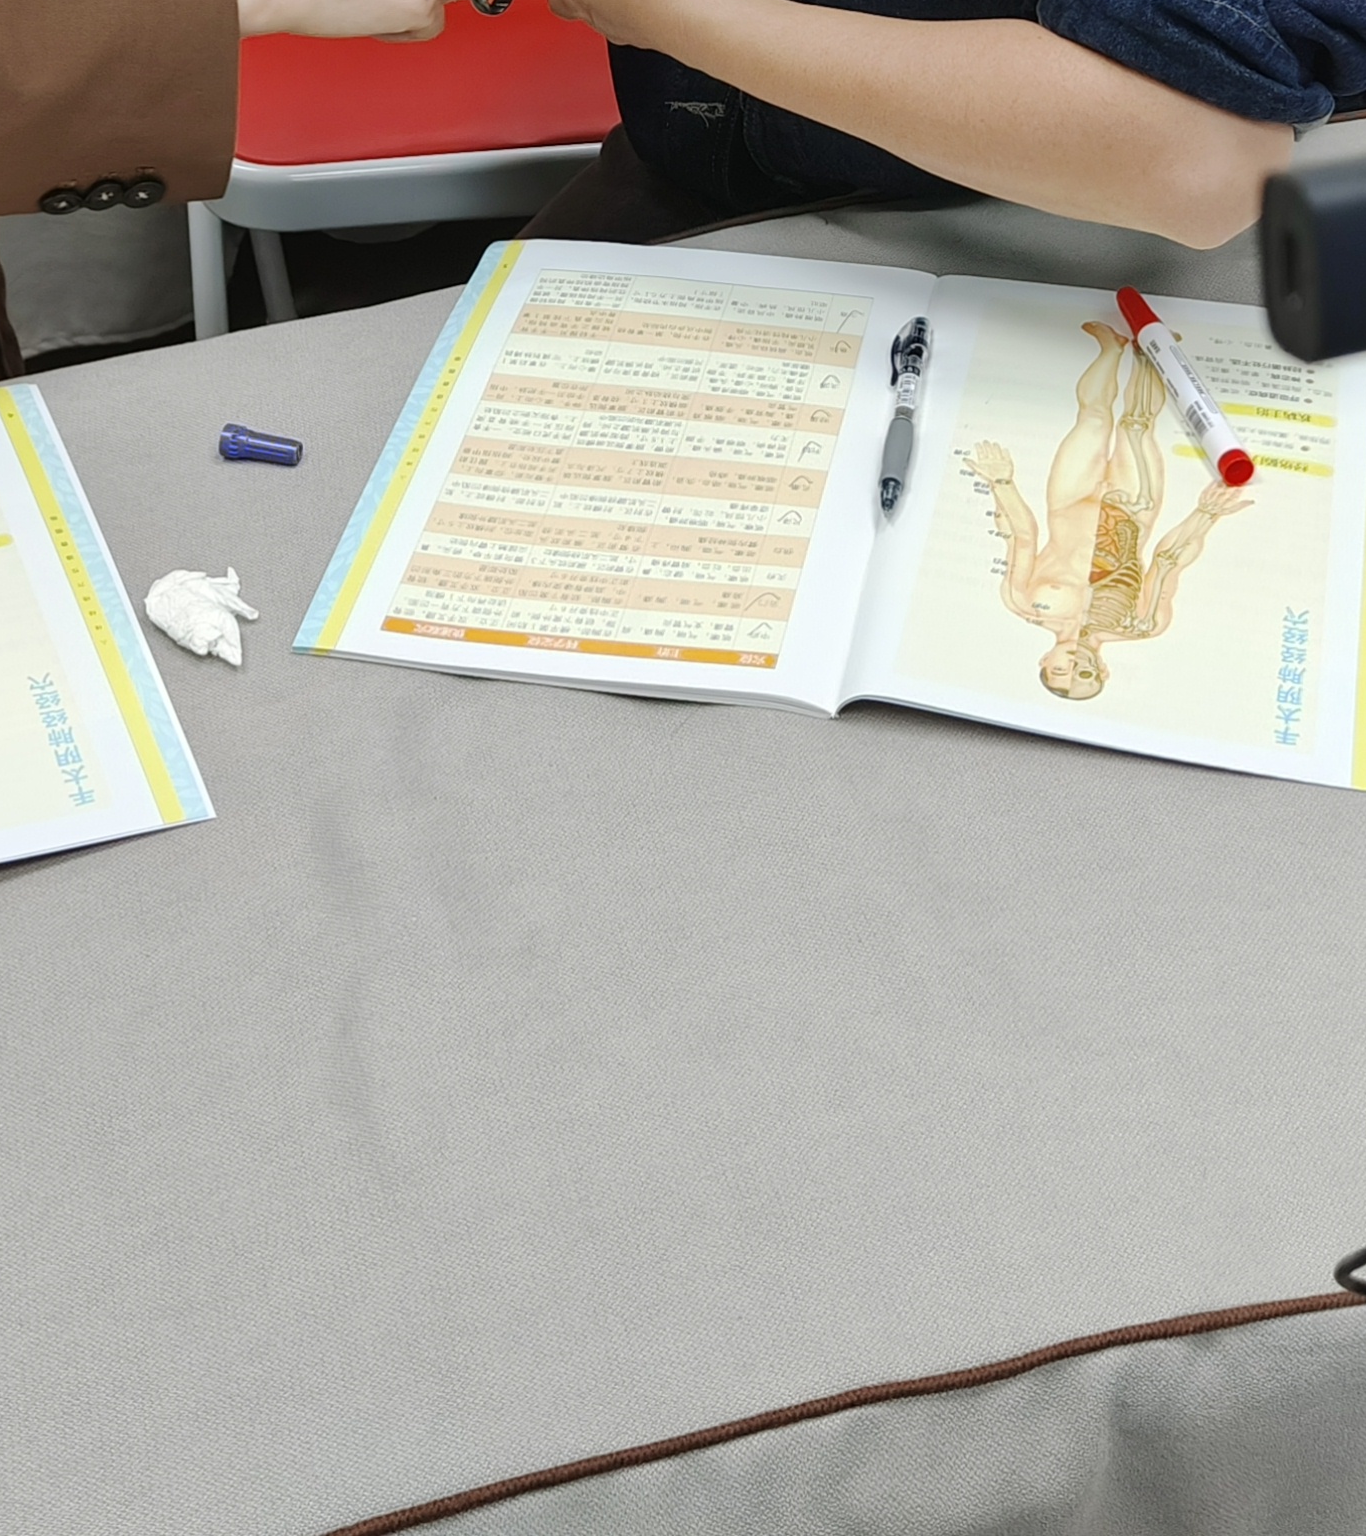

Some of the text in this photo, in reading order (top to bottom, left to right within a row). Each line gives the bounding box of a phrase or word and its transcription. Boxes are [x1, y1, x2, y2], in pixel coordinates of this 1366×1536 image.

[26, 670, 98, 808] 手太阴肺经经穴
[1271, 605, 1310, 748] 手太阴肺经经穴
